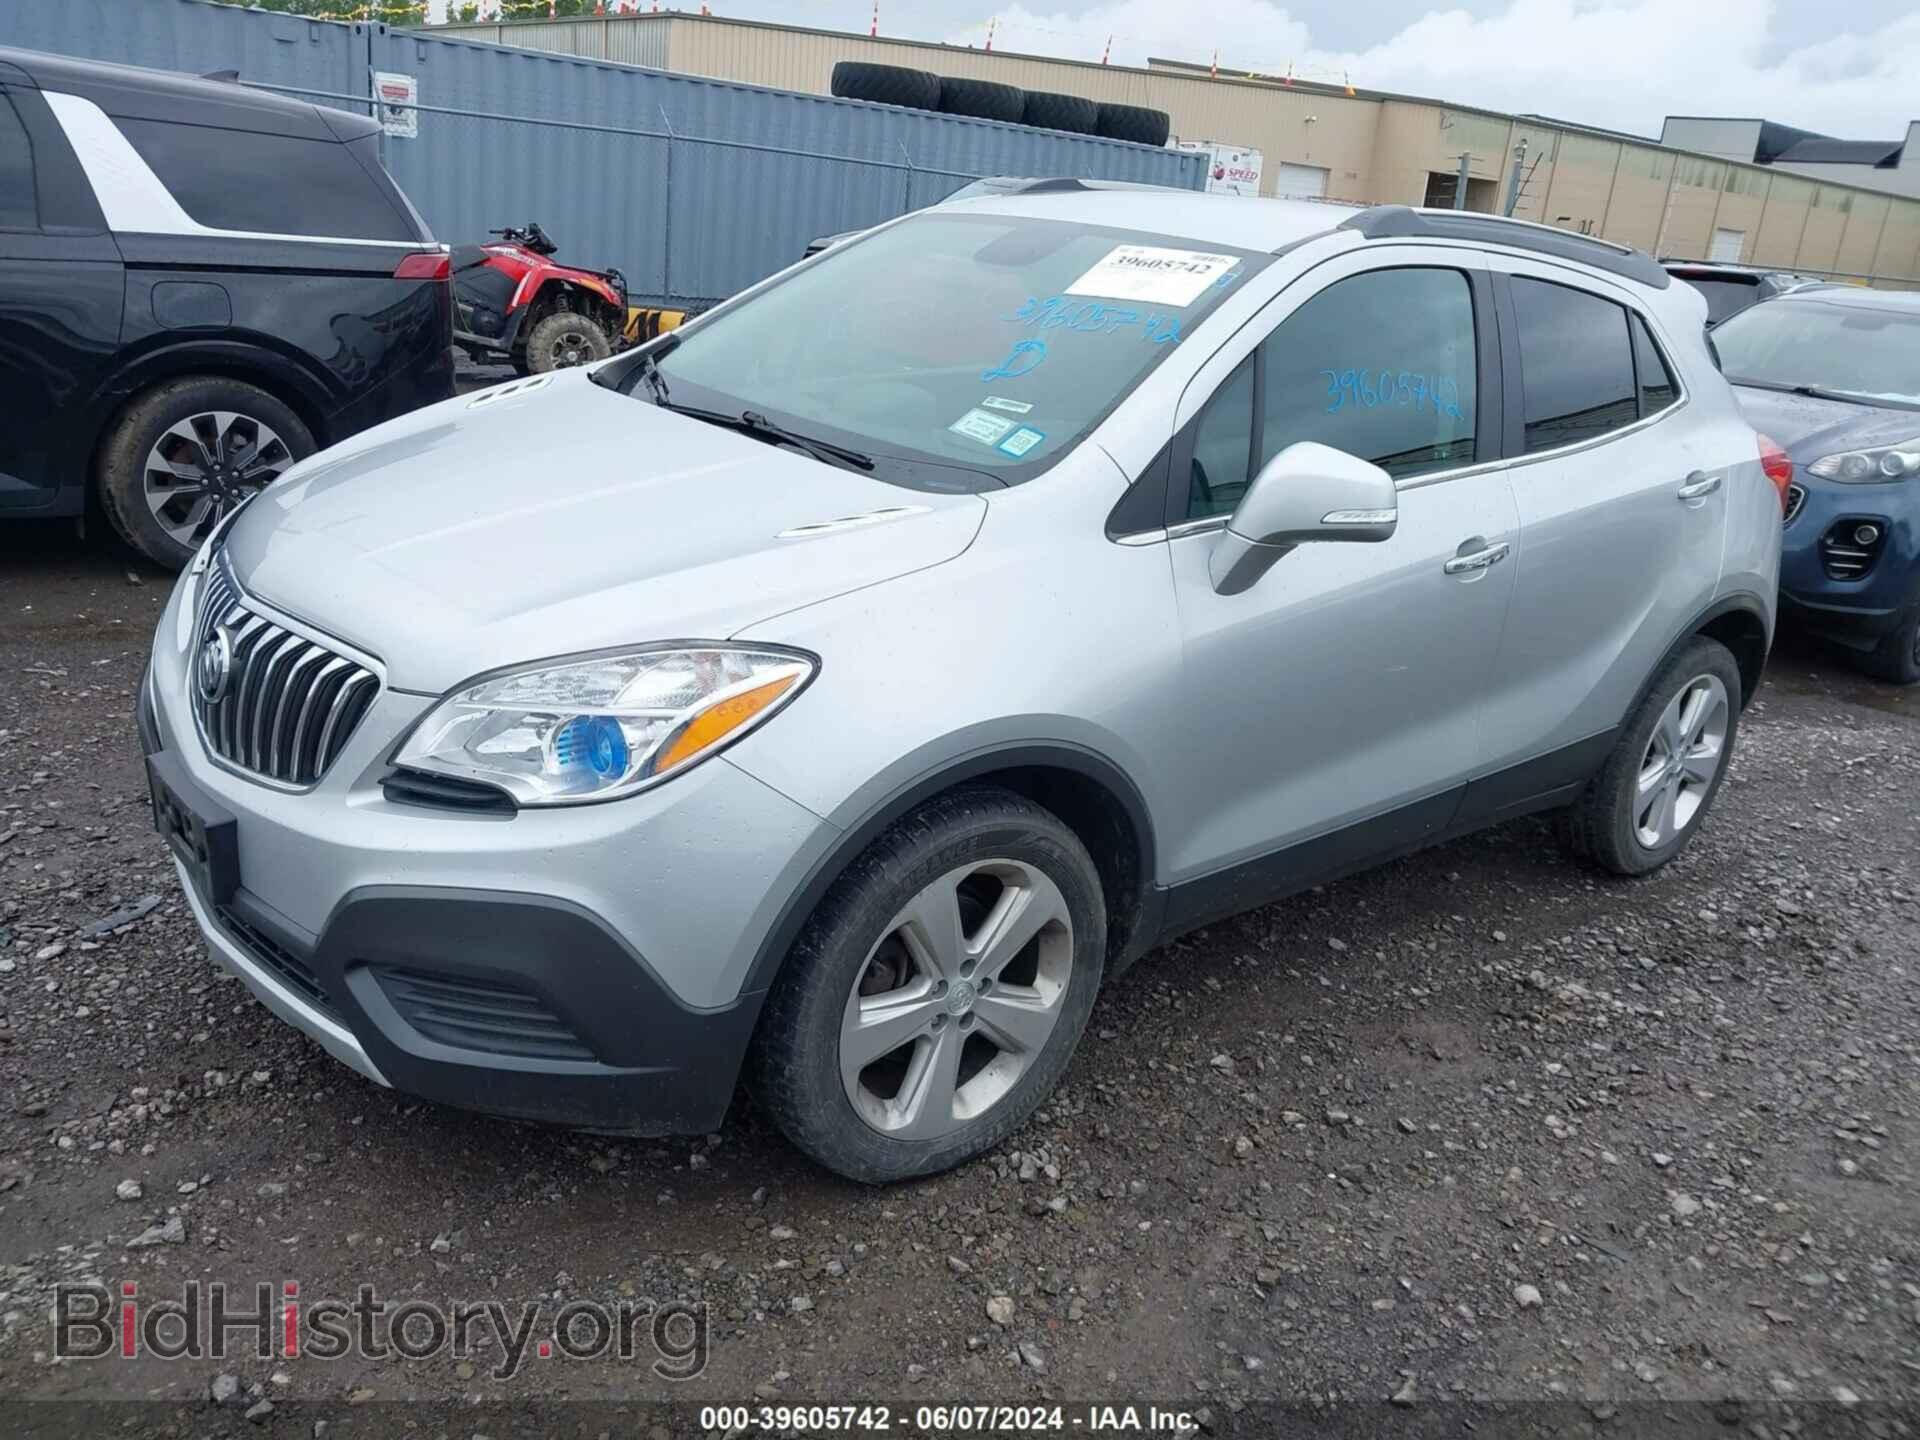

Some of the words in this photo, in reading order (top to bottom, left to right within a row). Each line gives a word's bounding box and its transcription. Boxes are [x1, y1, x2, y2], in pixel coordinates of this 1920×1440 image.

[1227, 168, 1258, 180] SPEED
[1111, 254, 1213, 275] 39605742
[1320, 368, 1464, 422] 39605742
